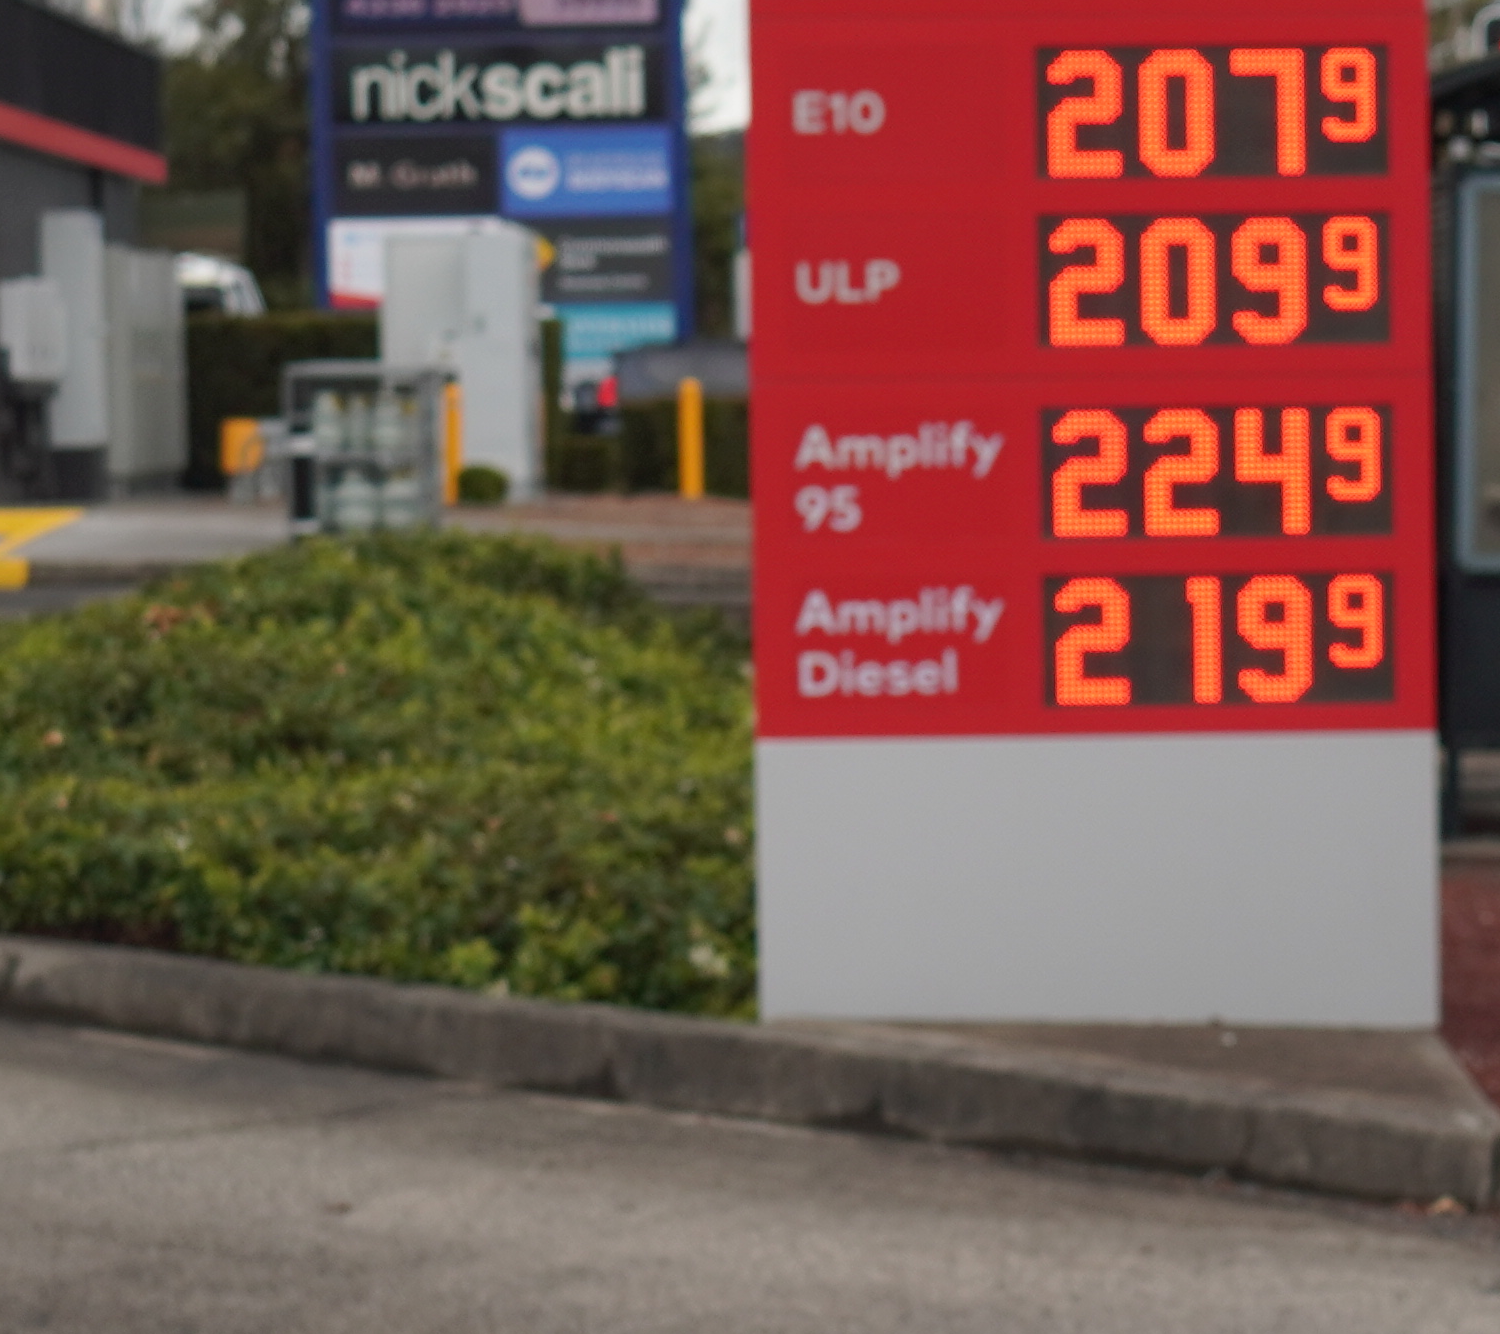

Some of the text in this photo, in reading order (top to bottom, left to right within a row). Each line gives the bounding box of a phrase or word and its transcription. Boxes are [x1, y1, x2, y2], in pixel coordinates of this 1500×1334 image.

[791, 89, 887, 135] E10
[795, 260, 901, 305] ULP
[795, 421, 1004, 479] Amplify
[796, 487, 862, 534] 95
[796, 586, 1005, 643] Amplify
[798, 649, 959, 698] Diesel
